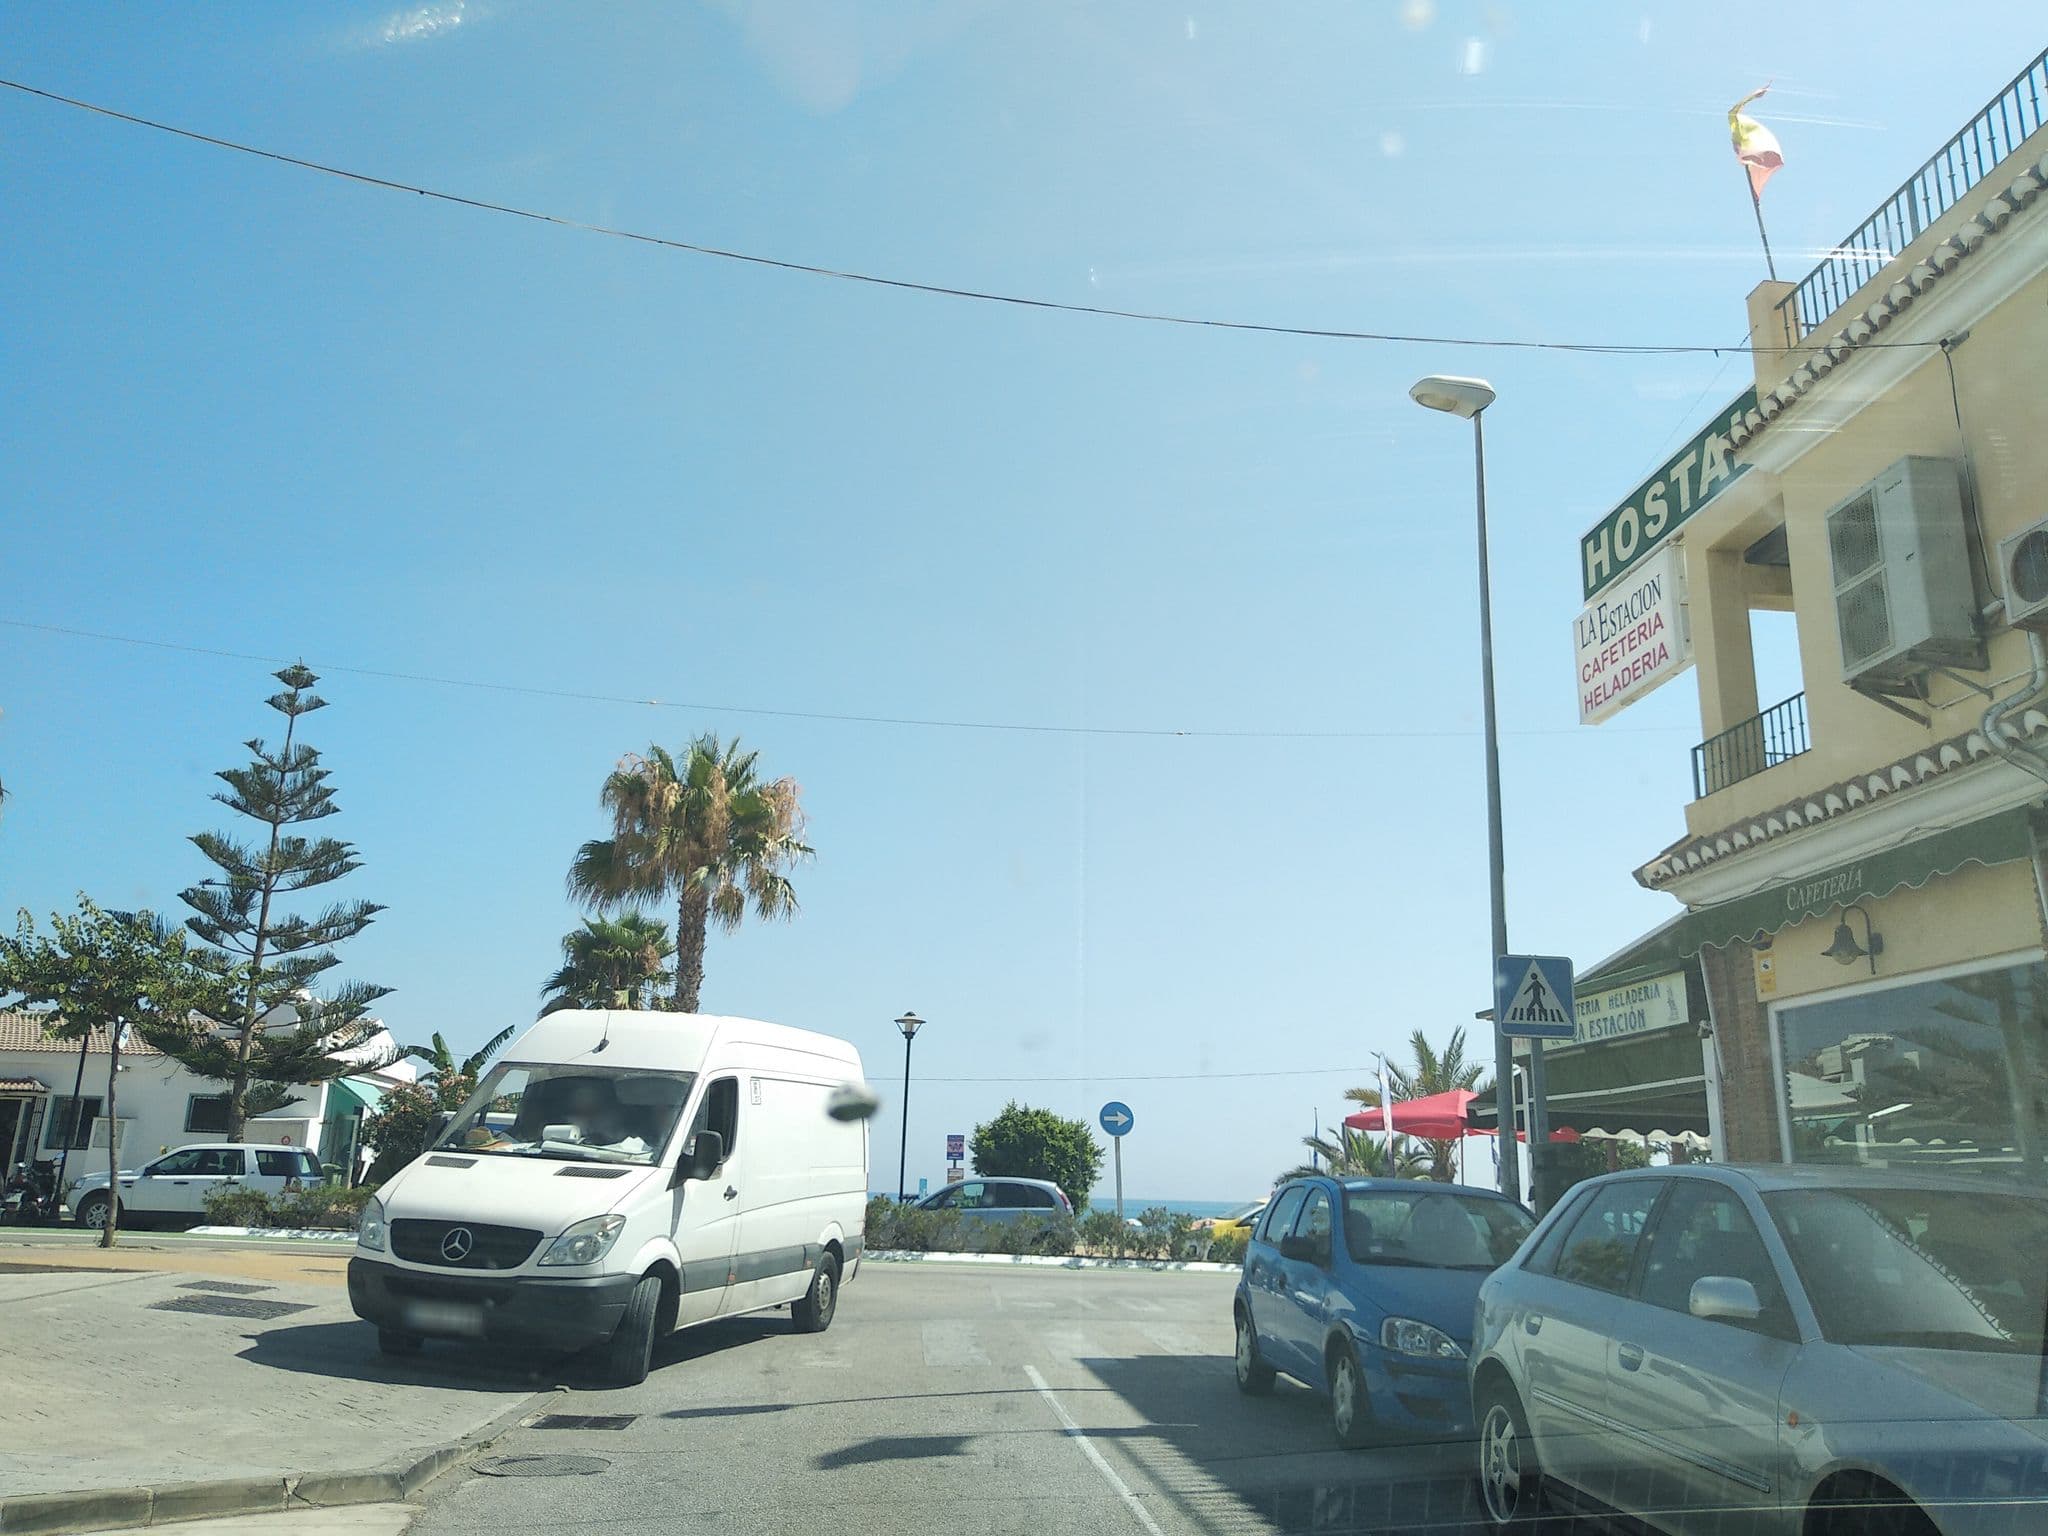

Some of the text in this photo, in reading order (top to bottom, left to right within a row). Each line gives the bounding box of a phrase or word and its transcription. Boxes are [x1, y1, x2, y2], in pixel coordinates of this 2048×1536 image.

[1580, 574, 1662, 650] LA ESTACION
[1582, 612, 1664, 683] CAFETERIA
[1584, 642, 1669, 714] HELADERIA
[1575, 998, 1600, 1017] TERIA
